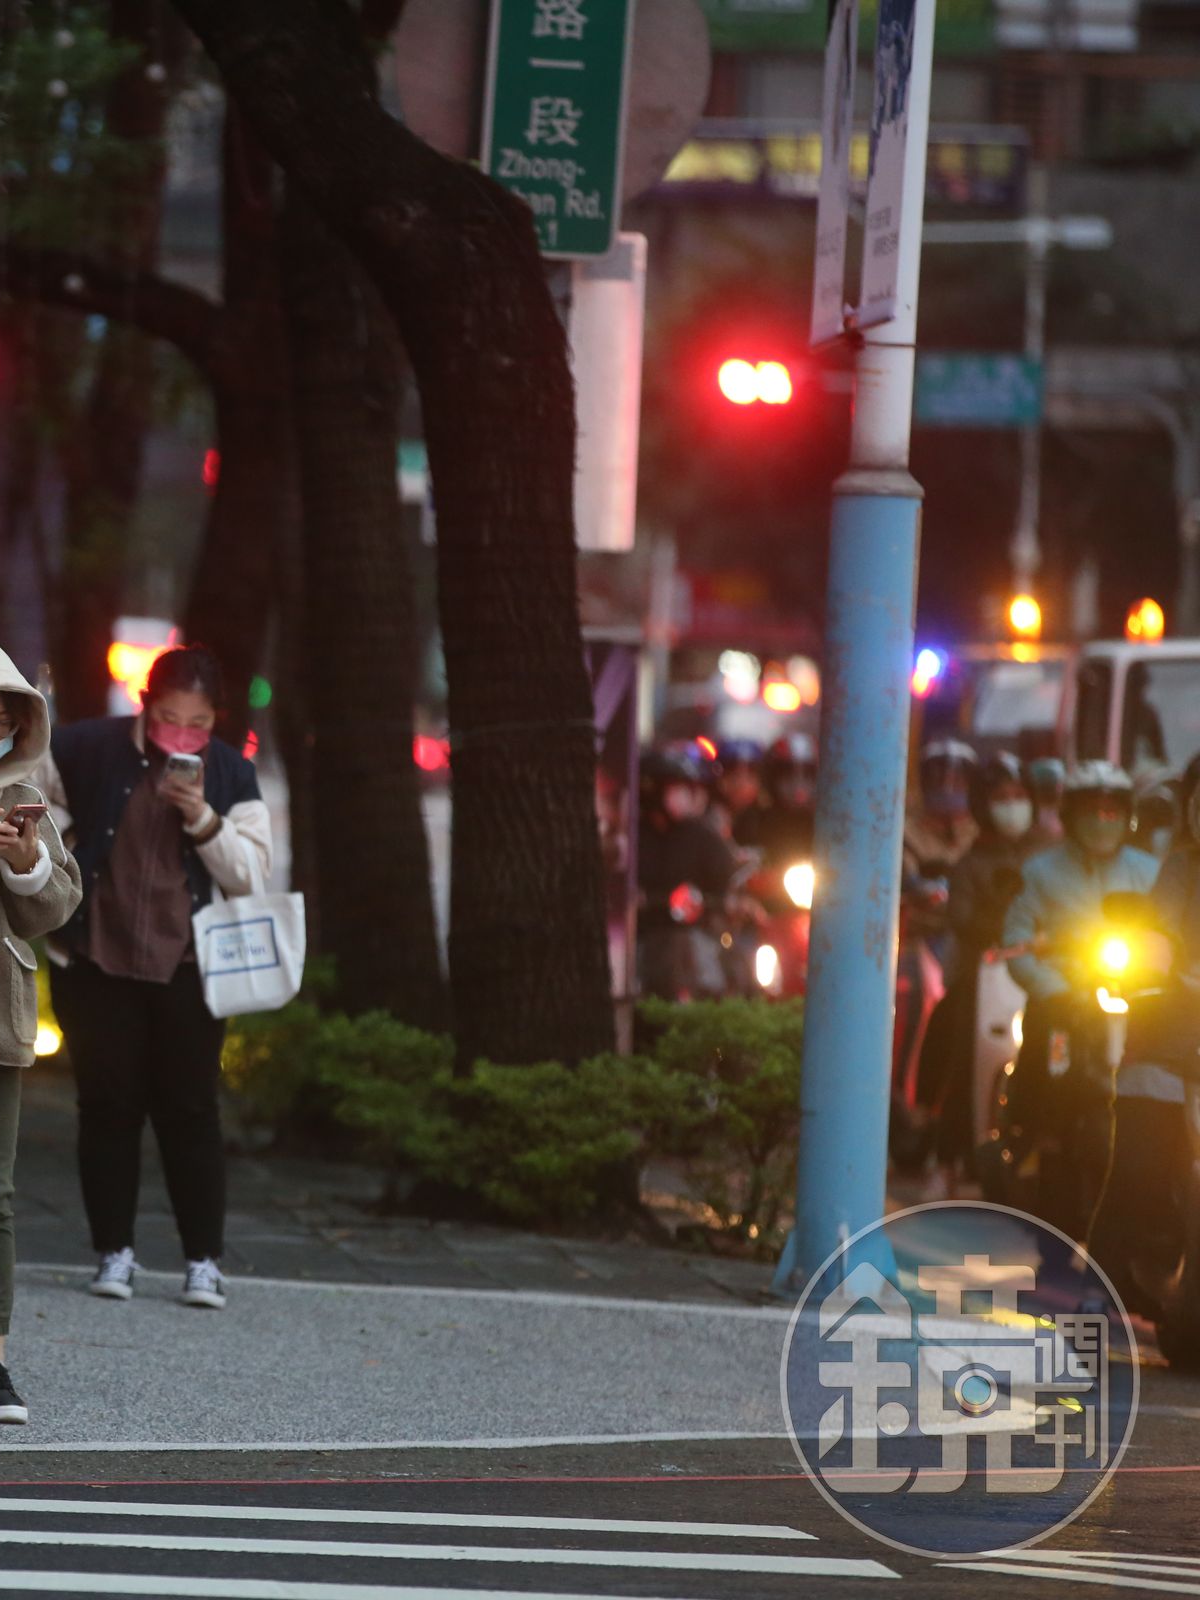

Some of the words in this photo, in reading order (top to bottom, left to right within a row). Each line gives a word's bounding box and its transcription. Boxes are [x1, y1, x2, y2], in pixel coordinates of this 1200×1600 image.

[524, 0, 589, 146] 路一段
[497, 148, 585, 187] Zhong-
[564, 187, 605, 219] Rd.
